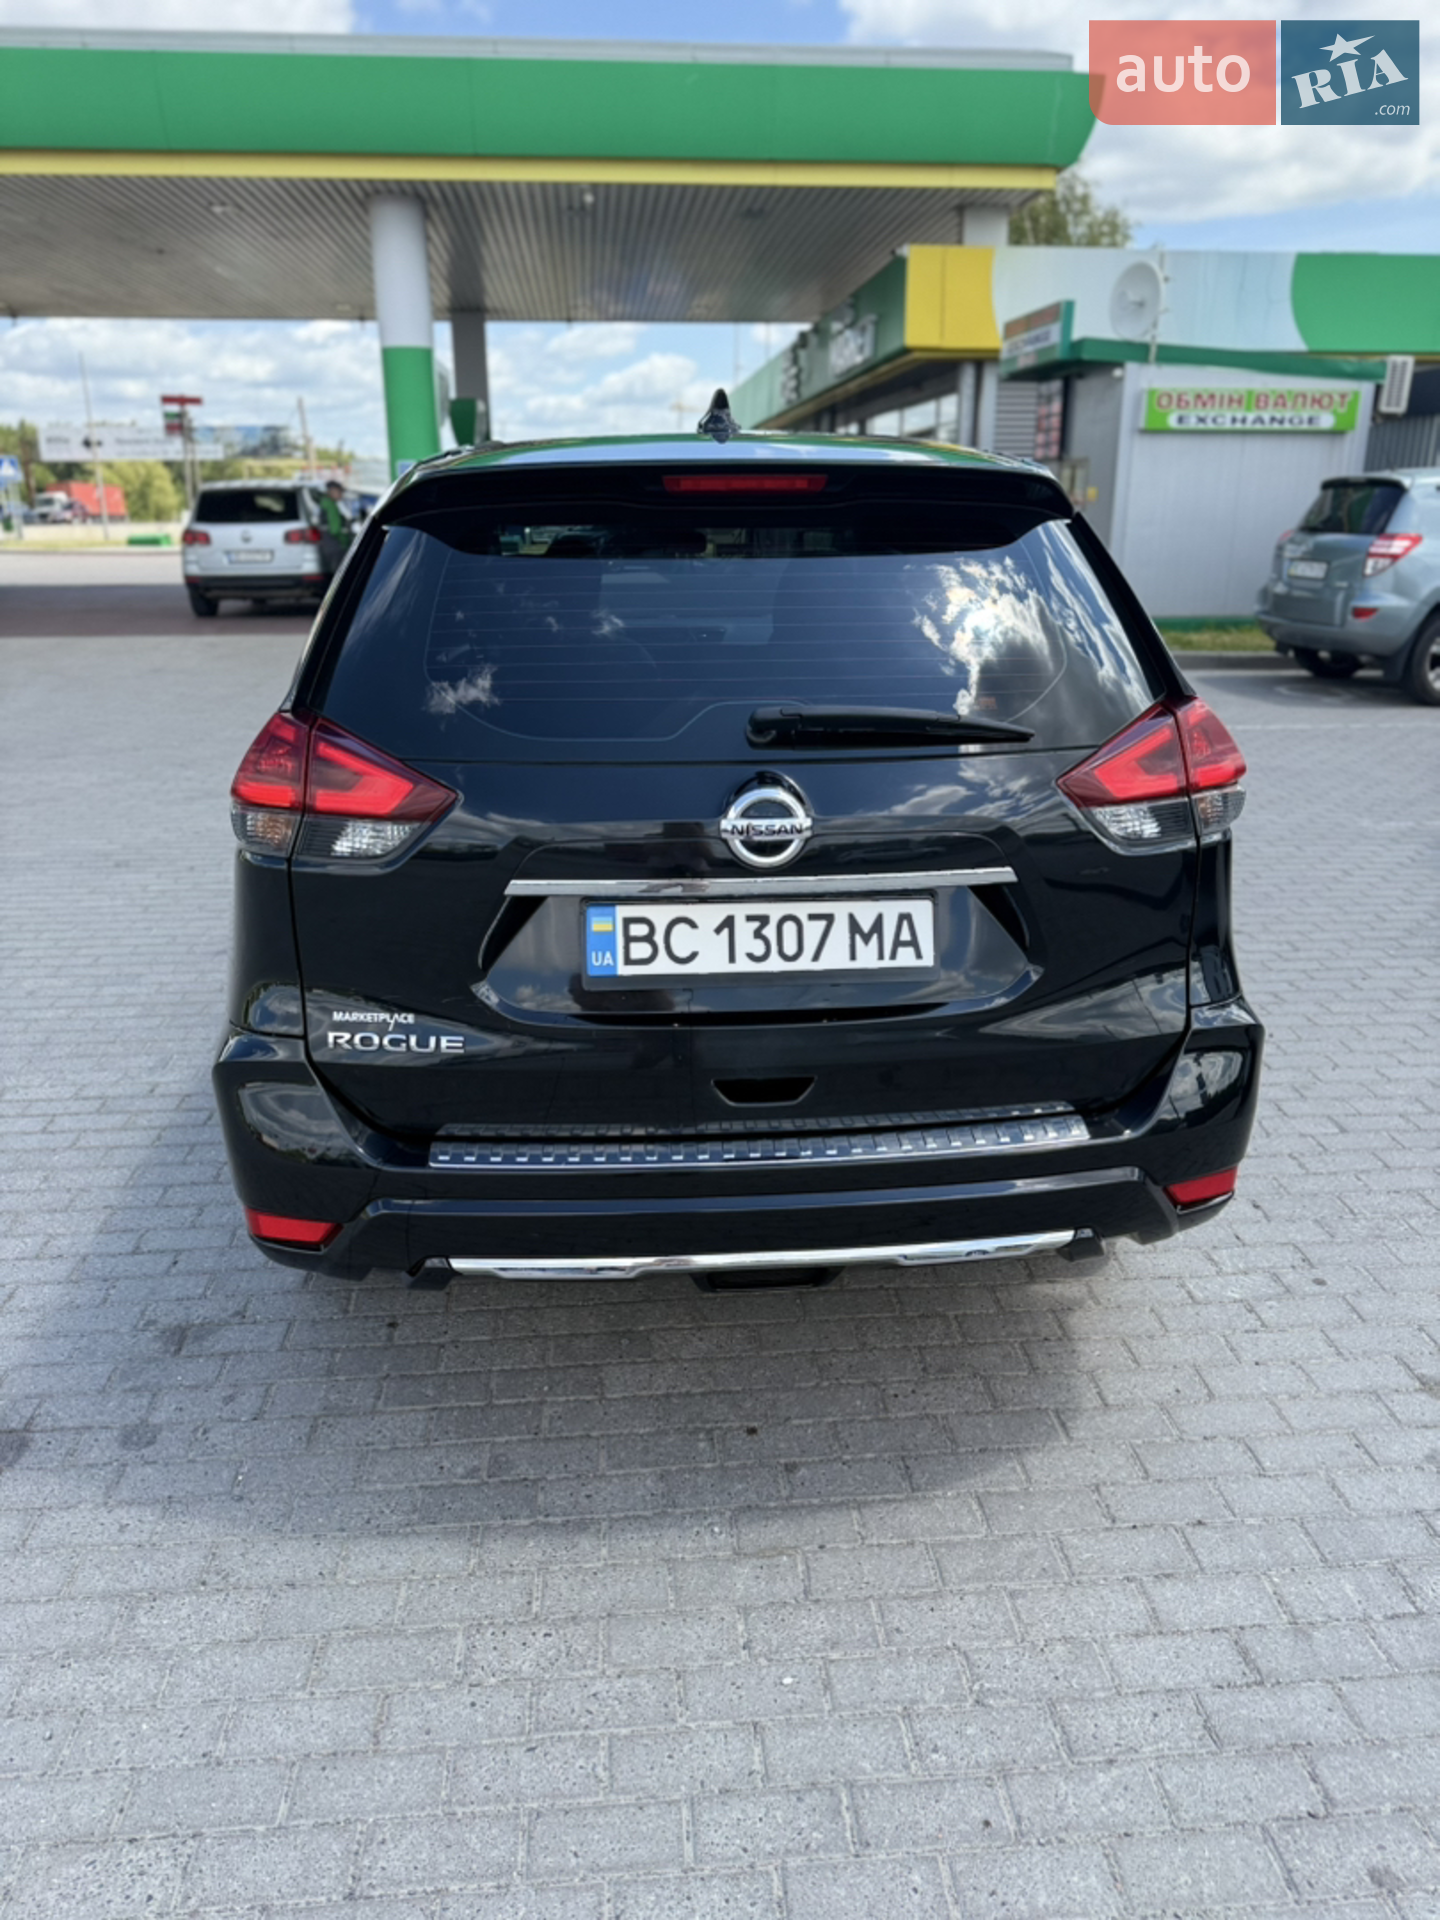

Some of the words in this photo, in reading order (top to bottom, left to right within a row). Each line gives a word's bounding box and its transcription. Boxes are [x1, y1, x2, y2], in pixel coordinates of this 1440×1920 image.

[1155, 391, 1245, 411] ОБМІН
[1254, 391, 1351, 411] ВАЛЮТ
[1176, 414, 1322, 427] EXCHANGE
[730, 823, 804, 837] NISSAN
[621, 916, 699, 966] BC
[712, 912, 836, 964] 1307
[847, 912, 924, 962] MA
[591, 951, 615, 967] UA
[332, 1011, 415, 1030] MARKETPLACE
[327, 1031, 465, 1053] ROGUE
